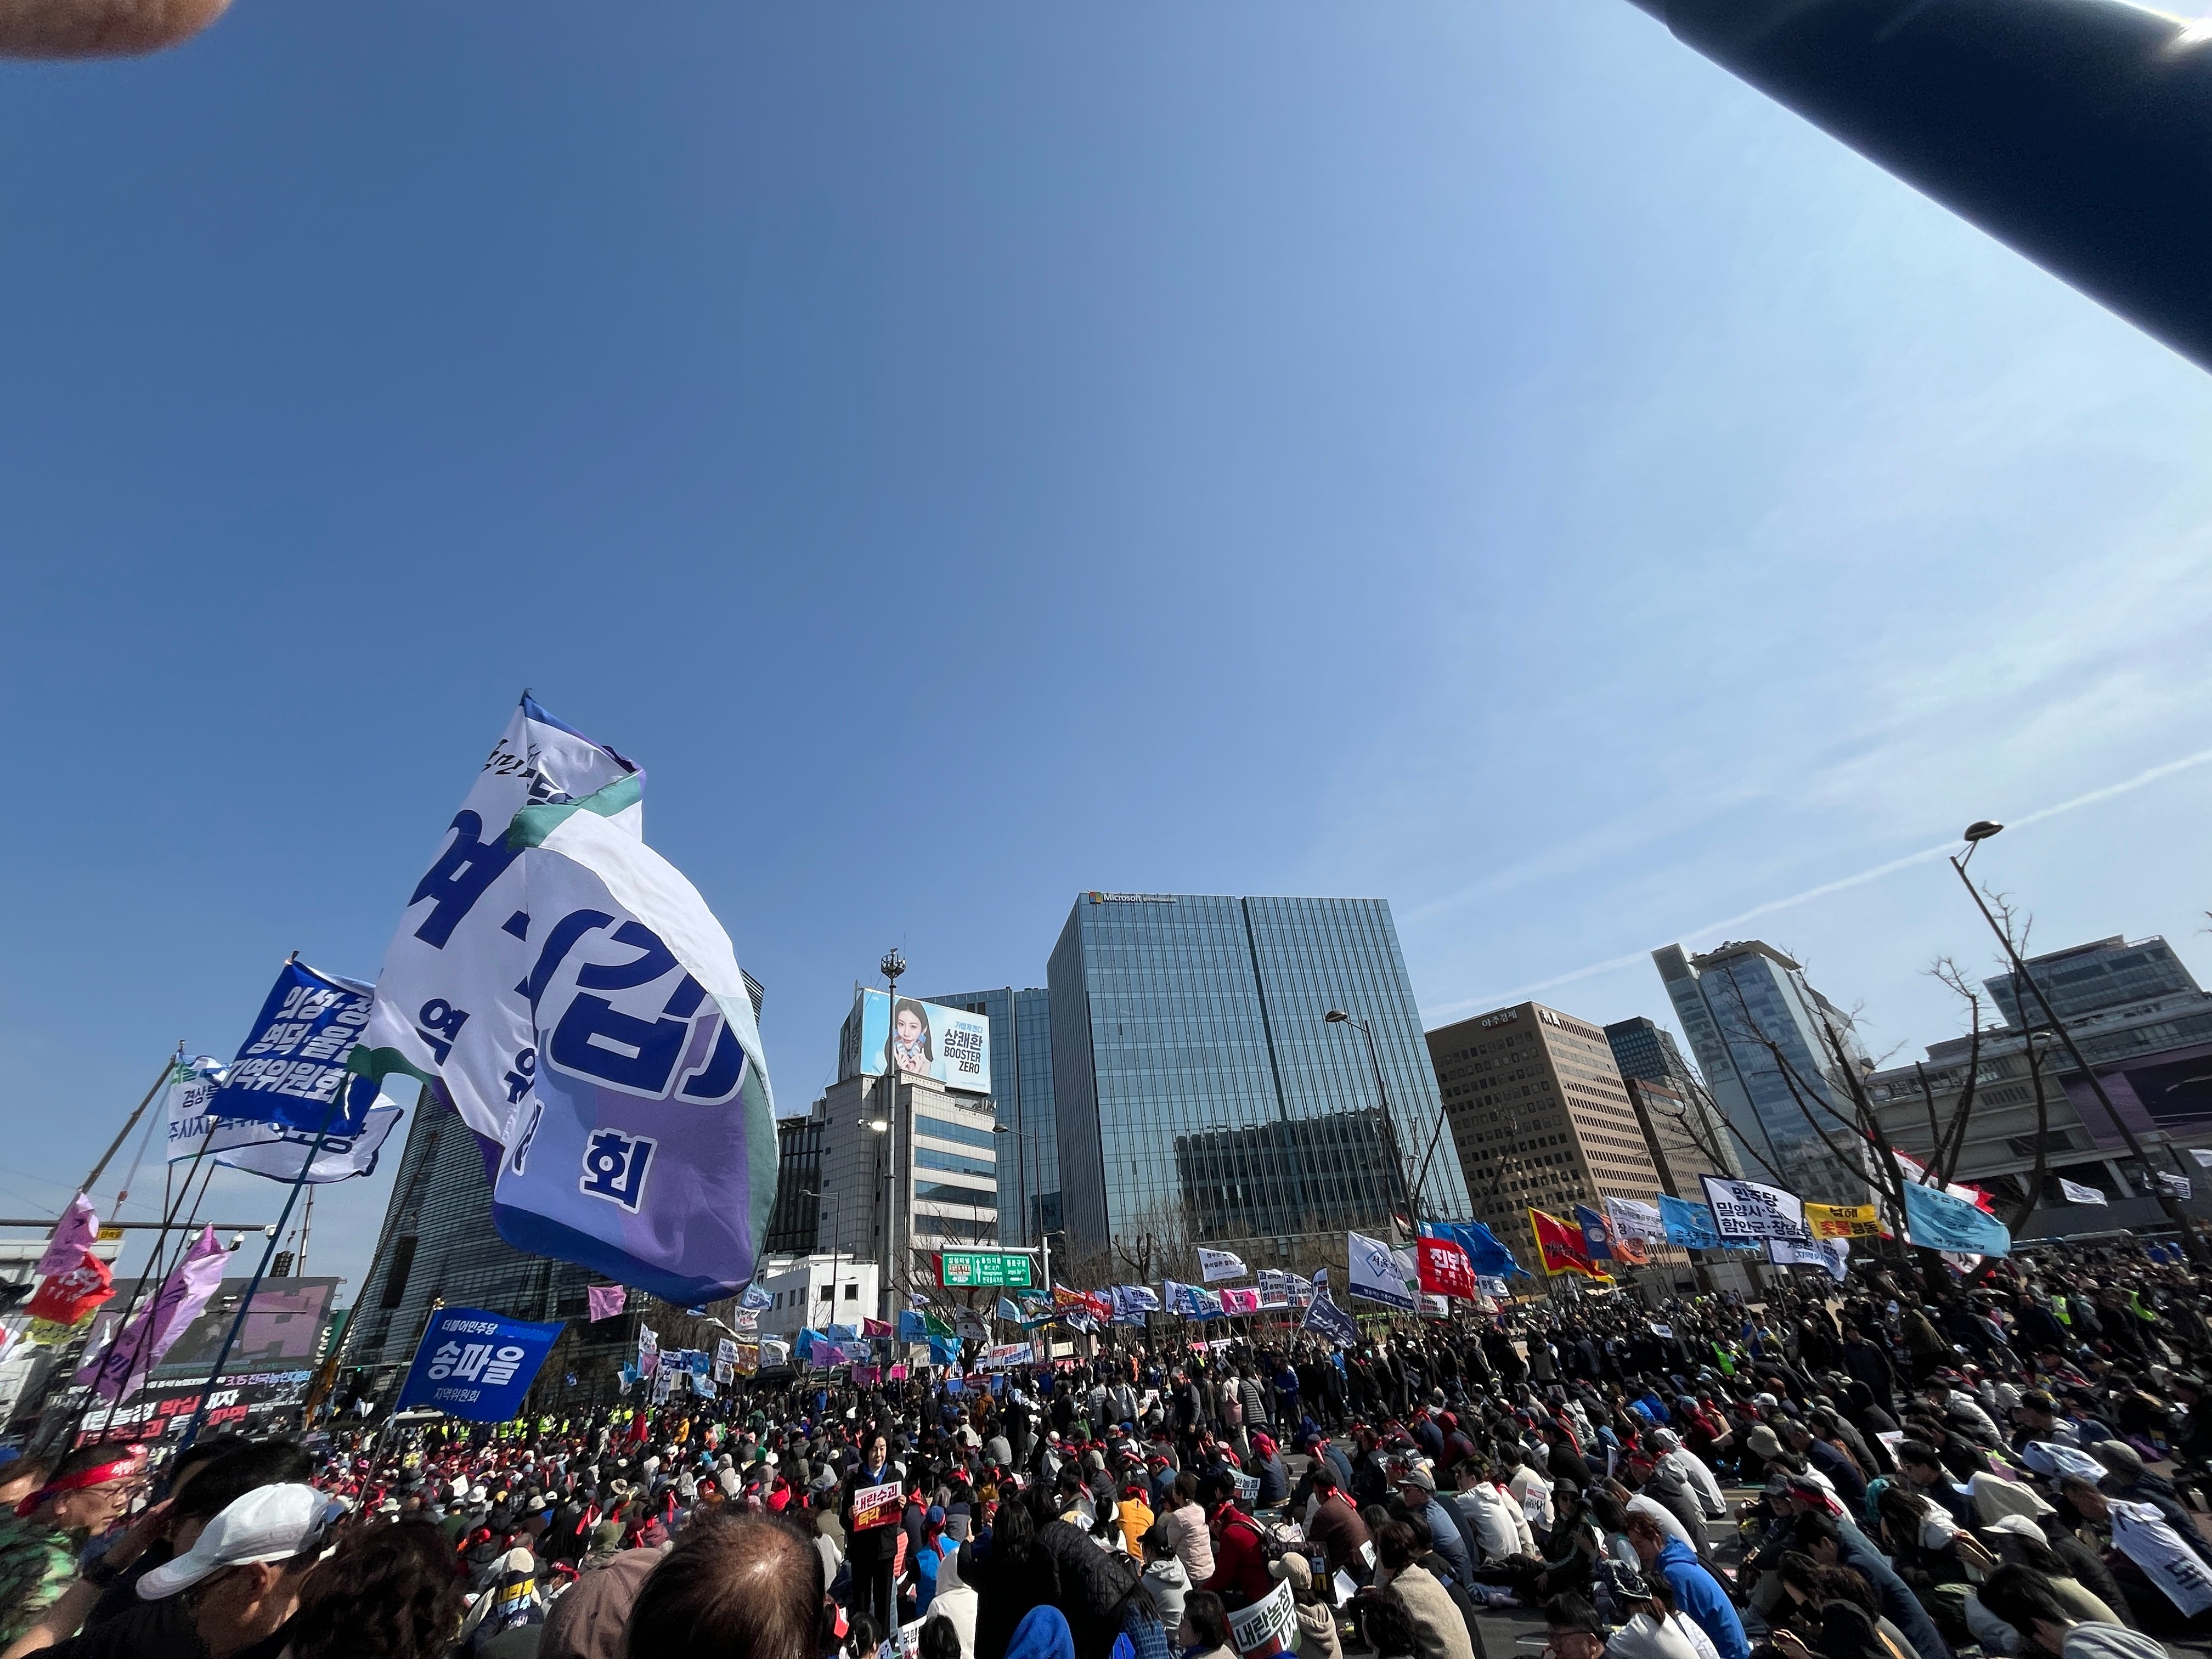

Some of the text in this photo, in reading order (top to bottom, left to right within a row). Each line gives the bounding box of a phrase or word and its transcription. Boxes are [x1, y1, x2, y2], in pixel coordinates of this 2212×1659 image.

[1103, 894, 1141, 902] Microsoft
[1482, 1010, 1518, 1028] 아주경제
[247, 1023, 363, 1063] 영덕·울
[944, 1029, 983, 1051] 상쾌환
[944, 1046, 981, 1063] BOOSTER
[958, 1060, 980, 1074] ZERO
[221, 1058, 348, 1104] 지역위원회
[1731, 1187, 1779, 1207] 민주당
[441, 1319, 498, 1335] 더불어민주당
[428, 1340, 525, 1386] 송파을
[432, 1387, 481, 1403] 지역위원회
[1235, 1583, 1290, 1647] 내란농정
